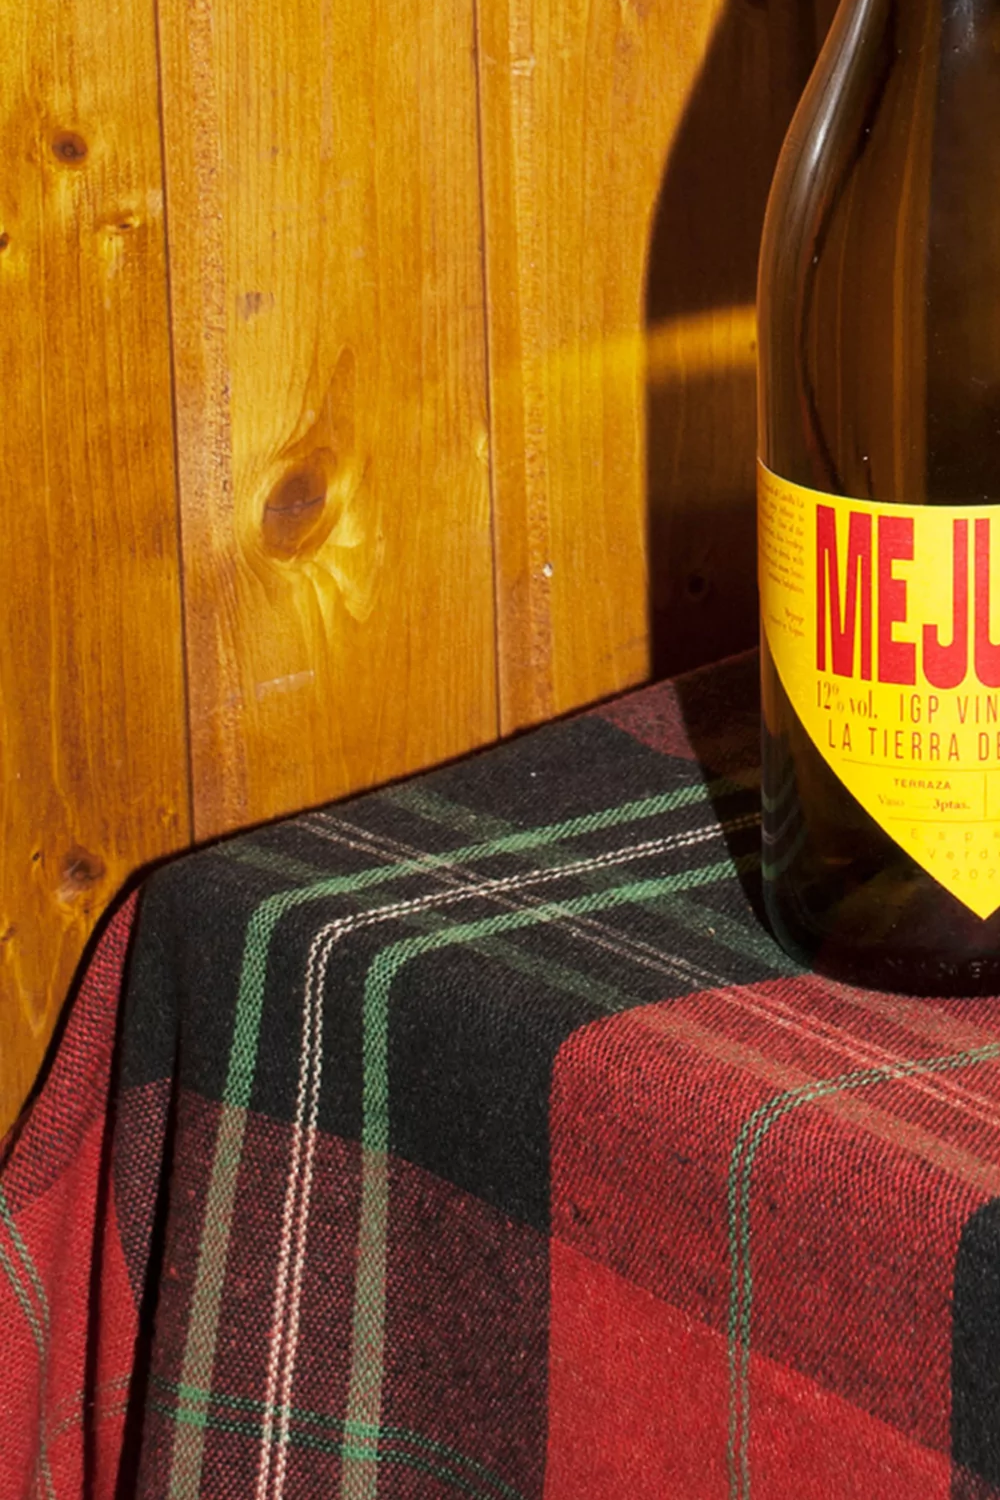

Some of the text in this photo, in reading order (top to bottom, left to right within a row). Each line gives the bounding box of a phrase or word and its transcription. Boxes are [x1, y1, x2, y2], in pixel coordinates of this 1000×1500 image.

[816, 679, 878, 719] 12% vol.
[899, 693, 939, 724] IGP
[828, 718, 853, 753] LA
[867, 726, 961, 762] TIERRA
[893, 777, 952, 791] TERRAZA
